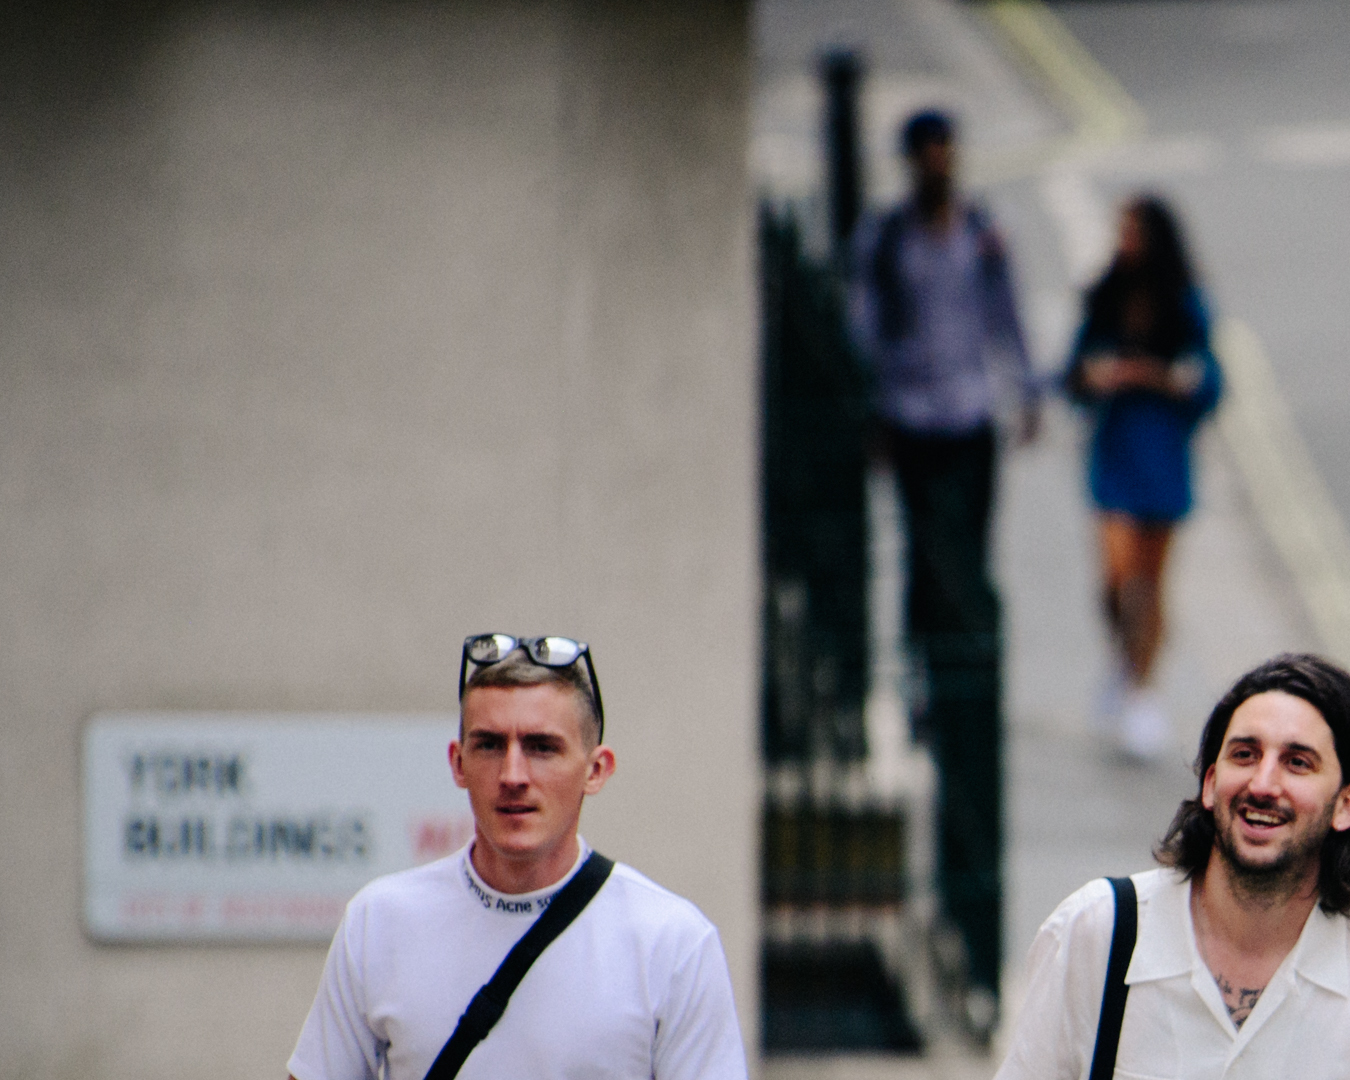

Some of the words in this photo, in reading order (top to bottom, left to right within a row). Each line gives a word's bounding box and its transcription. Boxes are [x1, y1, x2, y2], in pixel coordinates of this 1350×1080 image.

[125, 750, 248, 795] YORK
[124, 814, 373, 860] BUILDINGS
[496, 897, 533, 914] Acne
